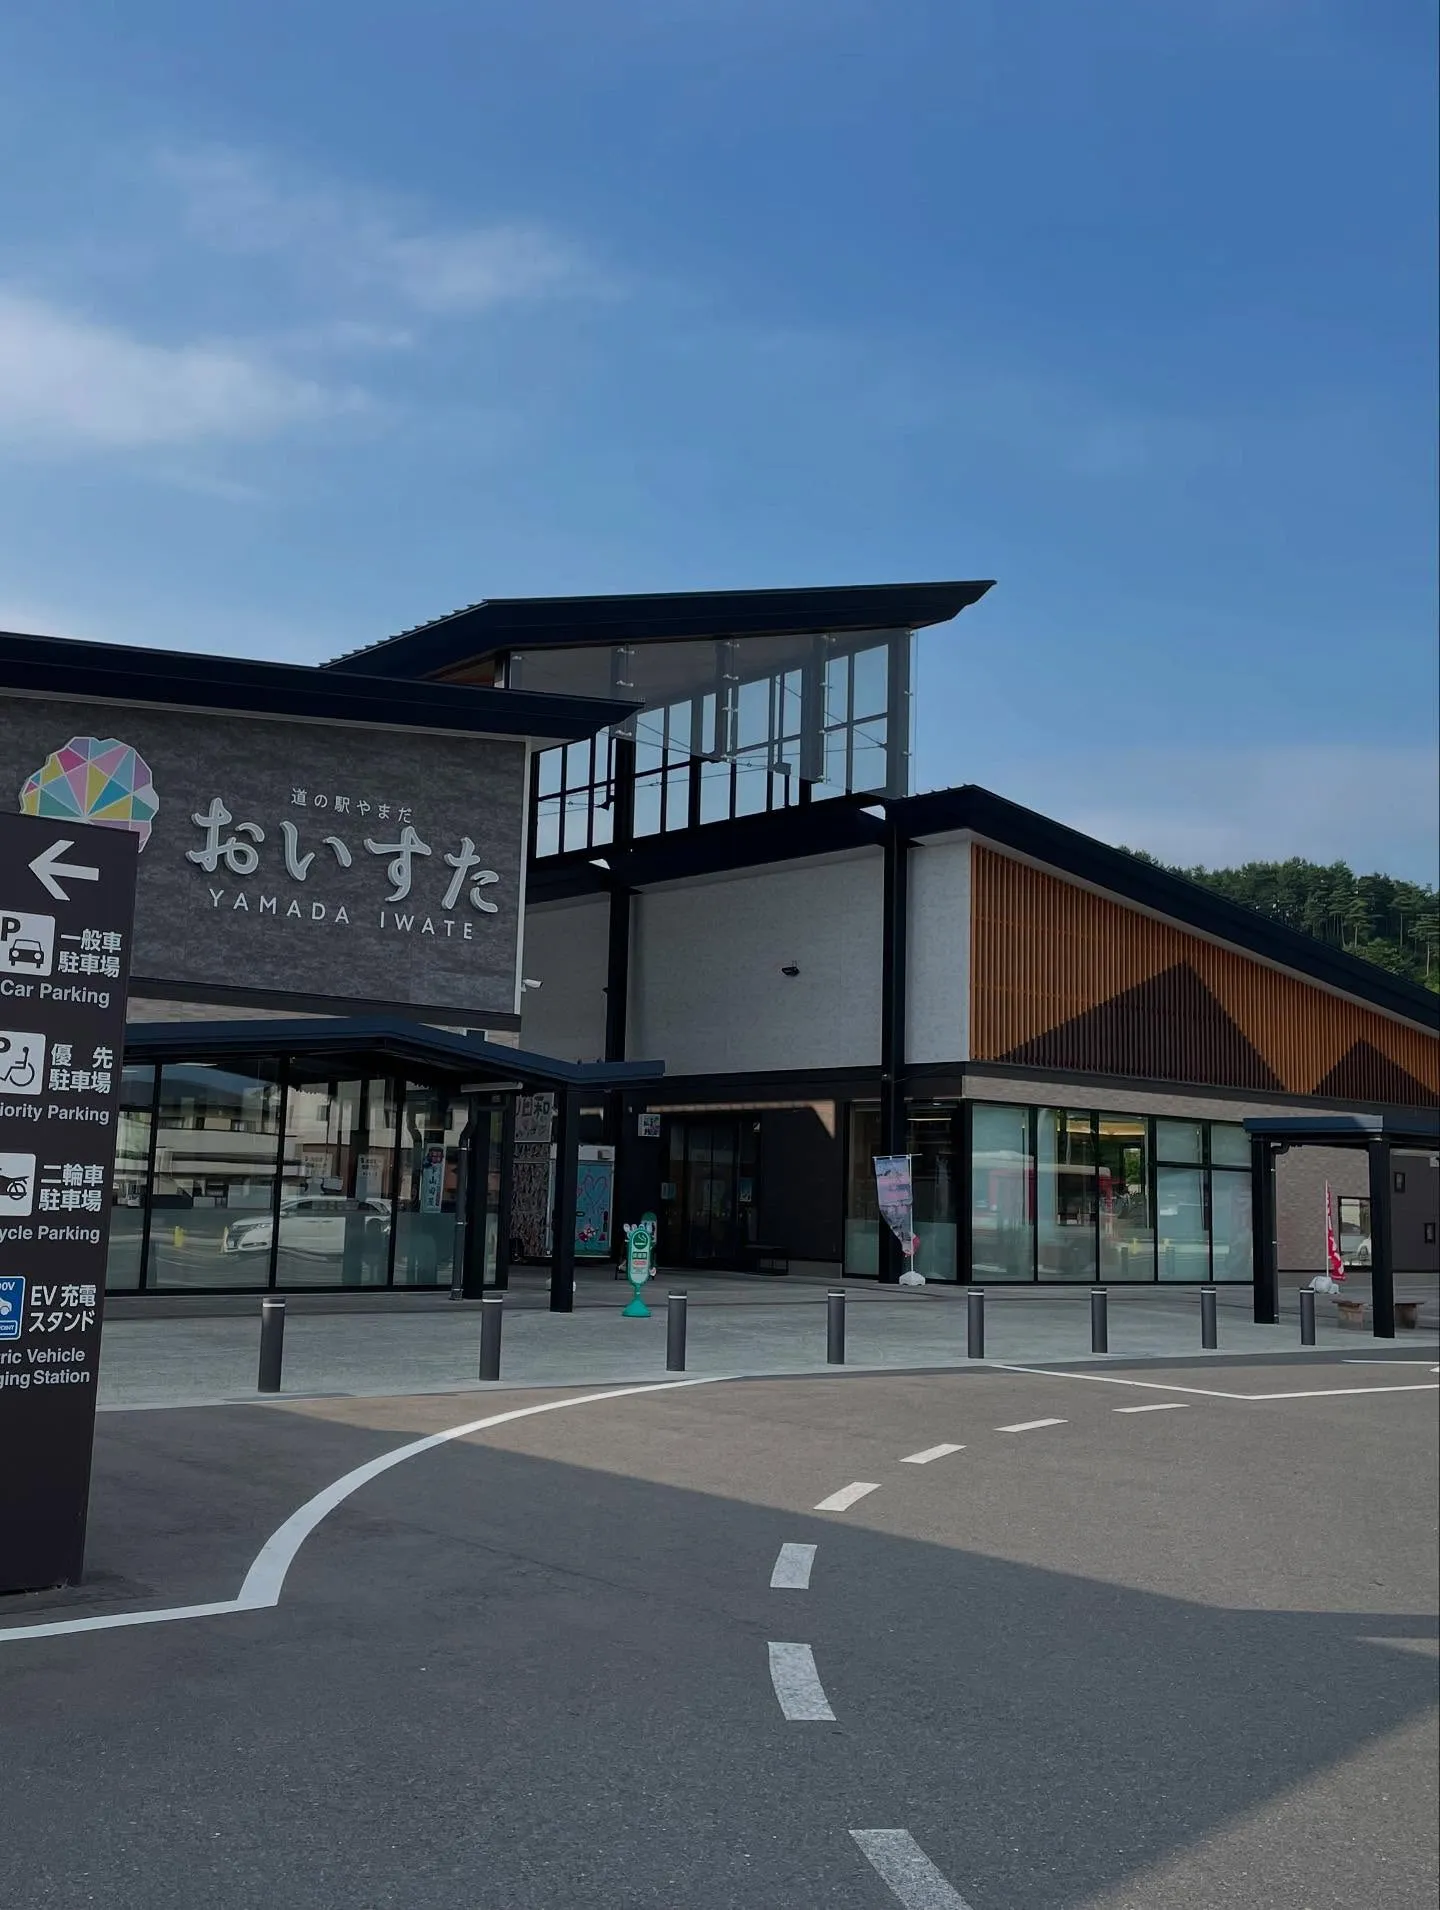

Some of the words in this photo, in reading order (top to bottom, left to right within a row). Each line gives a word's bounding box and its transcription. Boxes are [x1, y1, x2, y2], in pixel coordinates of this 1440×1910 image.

[291, 788, 413, 823] 道の駅やまだ
[185, 797, 499, 914] おいすた
[209, 888, 350, 924] YAMADA
[380, 911, 473, 940] IWATE
[60, 928, 122, 954] 一般車
[58, 951, 121, 978] 駐車場
[0, 979, 34, 998] Car
[39, 982, 110, 1008] Parking
[49, 1068, 112, 1094] 駐車場
[47, 1104, 110, 1125] Parking
[41, 1164, 104, 1187] 二輪車
[38, 1189, 102, 1212] 駐車場
[37, 1225, 100, 1244] Parking
[28, 1310, 95, 1333] スタンド
[27, 1347, 85, 1363] Vehicle
[33, 1369, 90, 1385] Station
